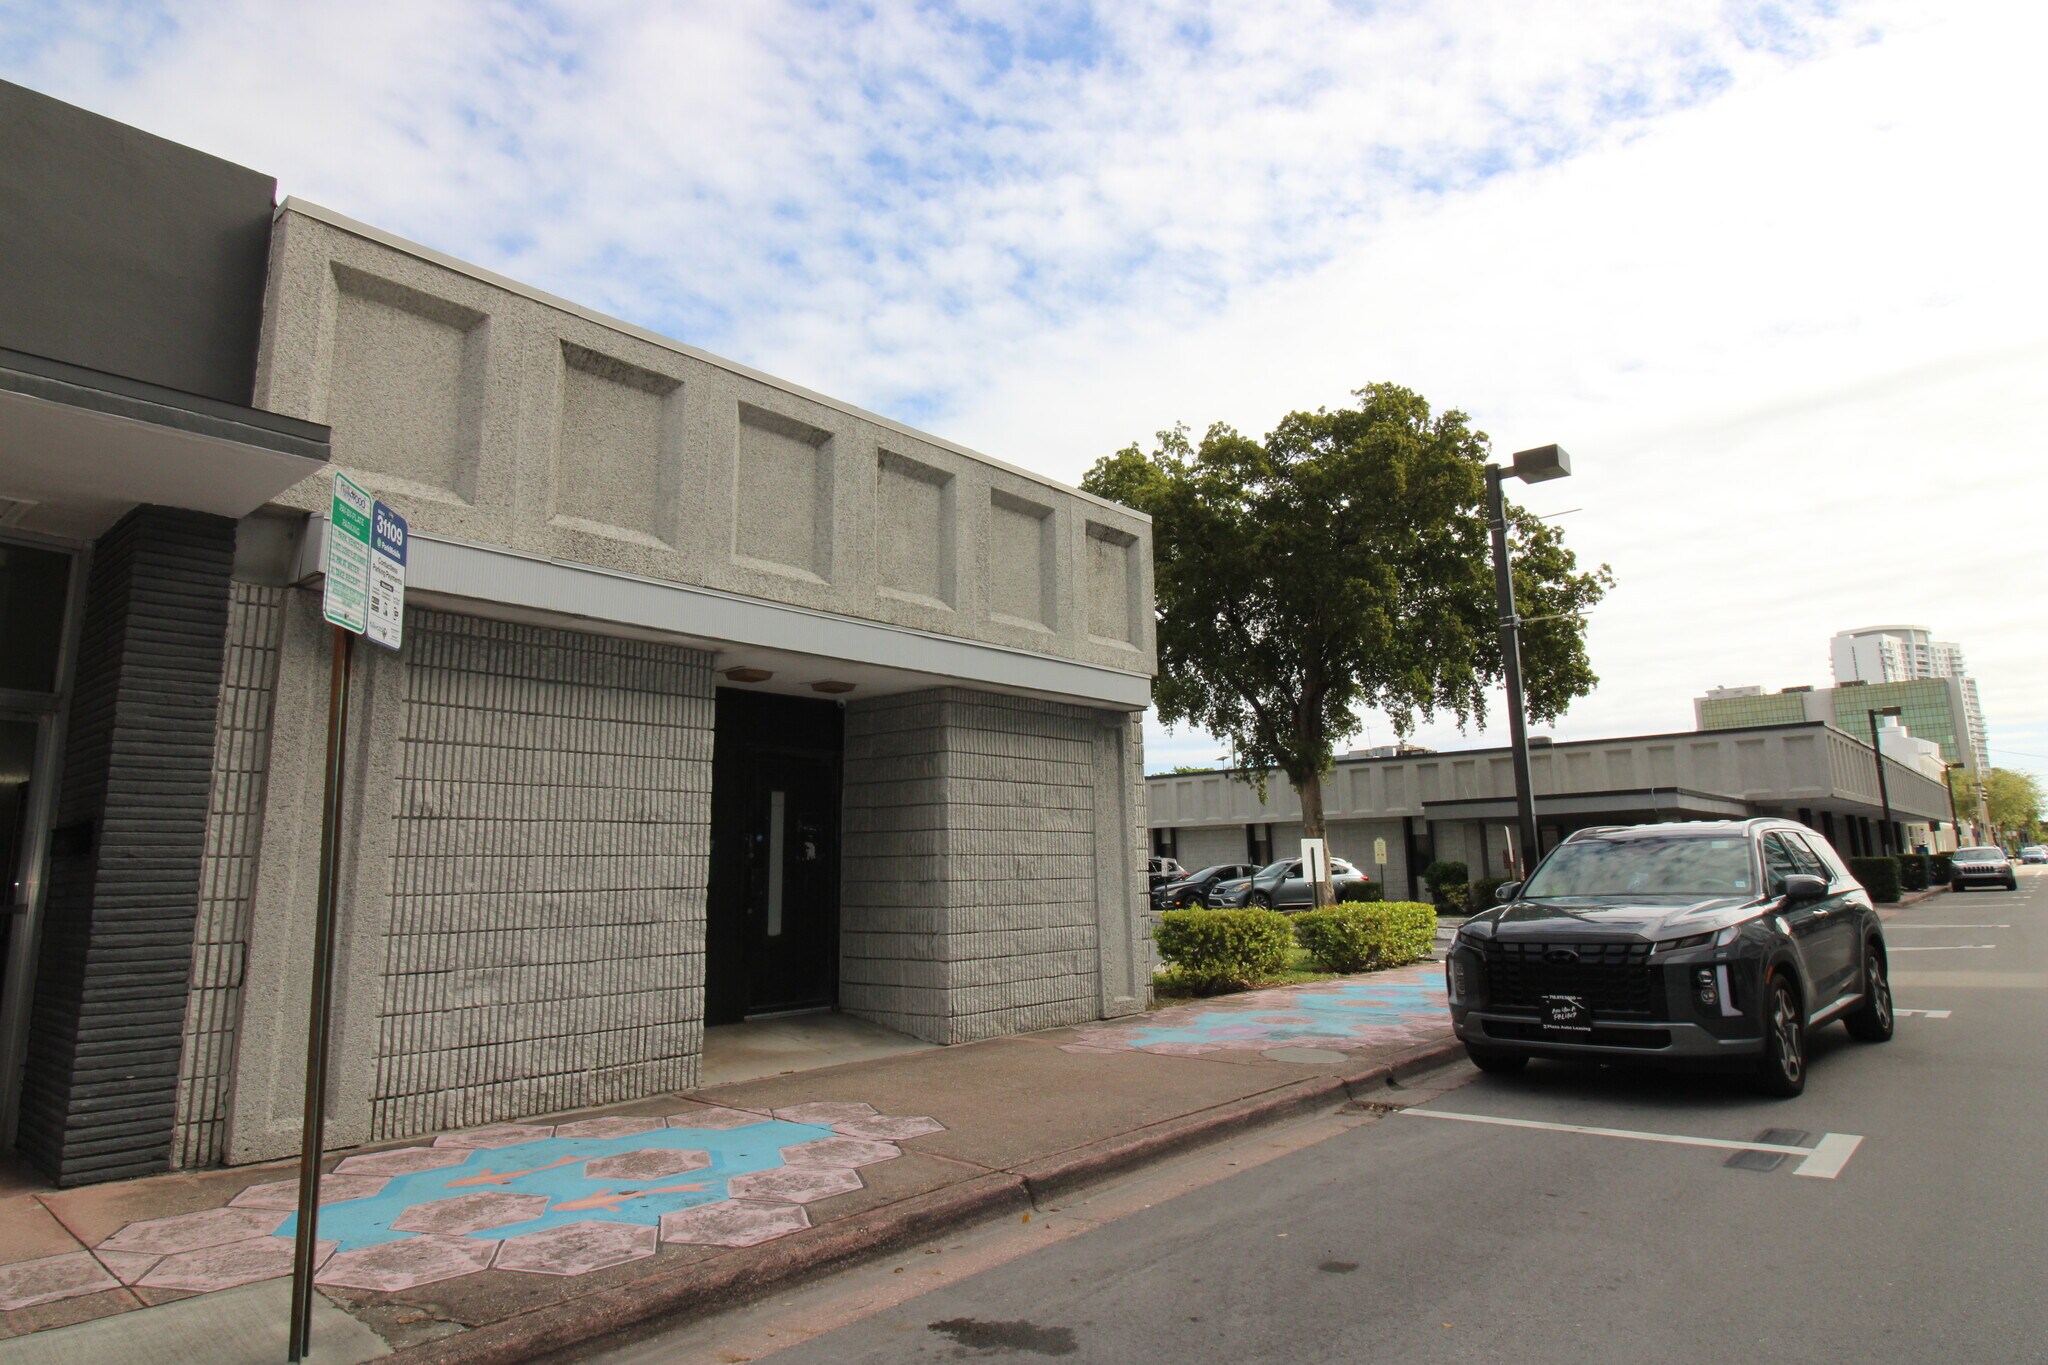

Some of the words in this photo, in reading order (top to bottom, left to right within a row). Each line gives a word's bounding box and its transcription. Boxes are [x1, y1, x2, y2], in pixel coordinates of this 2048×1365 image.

[342, 518, 360, 536] PARKING
[377, 515, 403, 546] 31109
[381, 541, 401, 559] ParkMobile
[372, 563, 385, 578] Parking
[385, 570, 402, 586] Payments
[378, 556, 398, 575] Contactless
